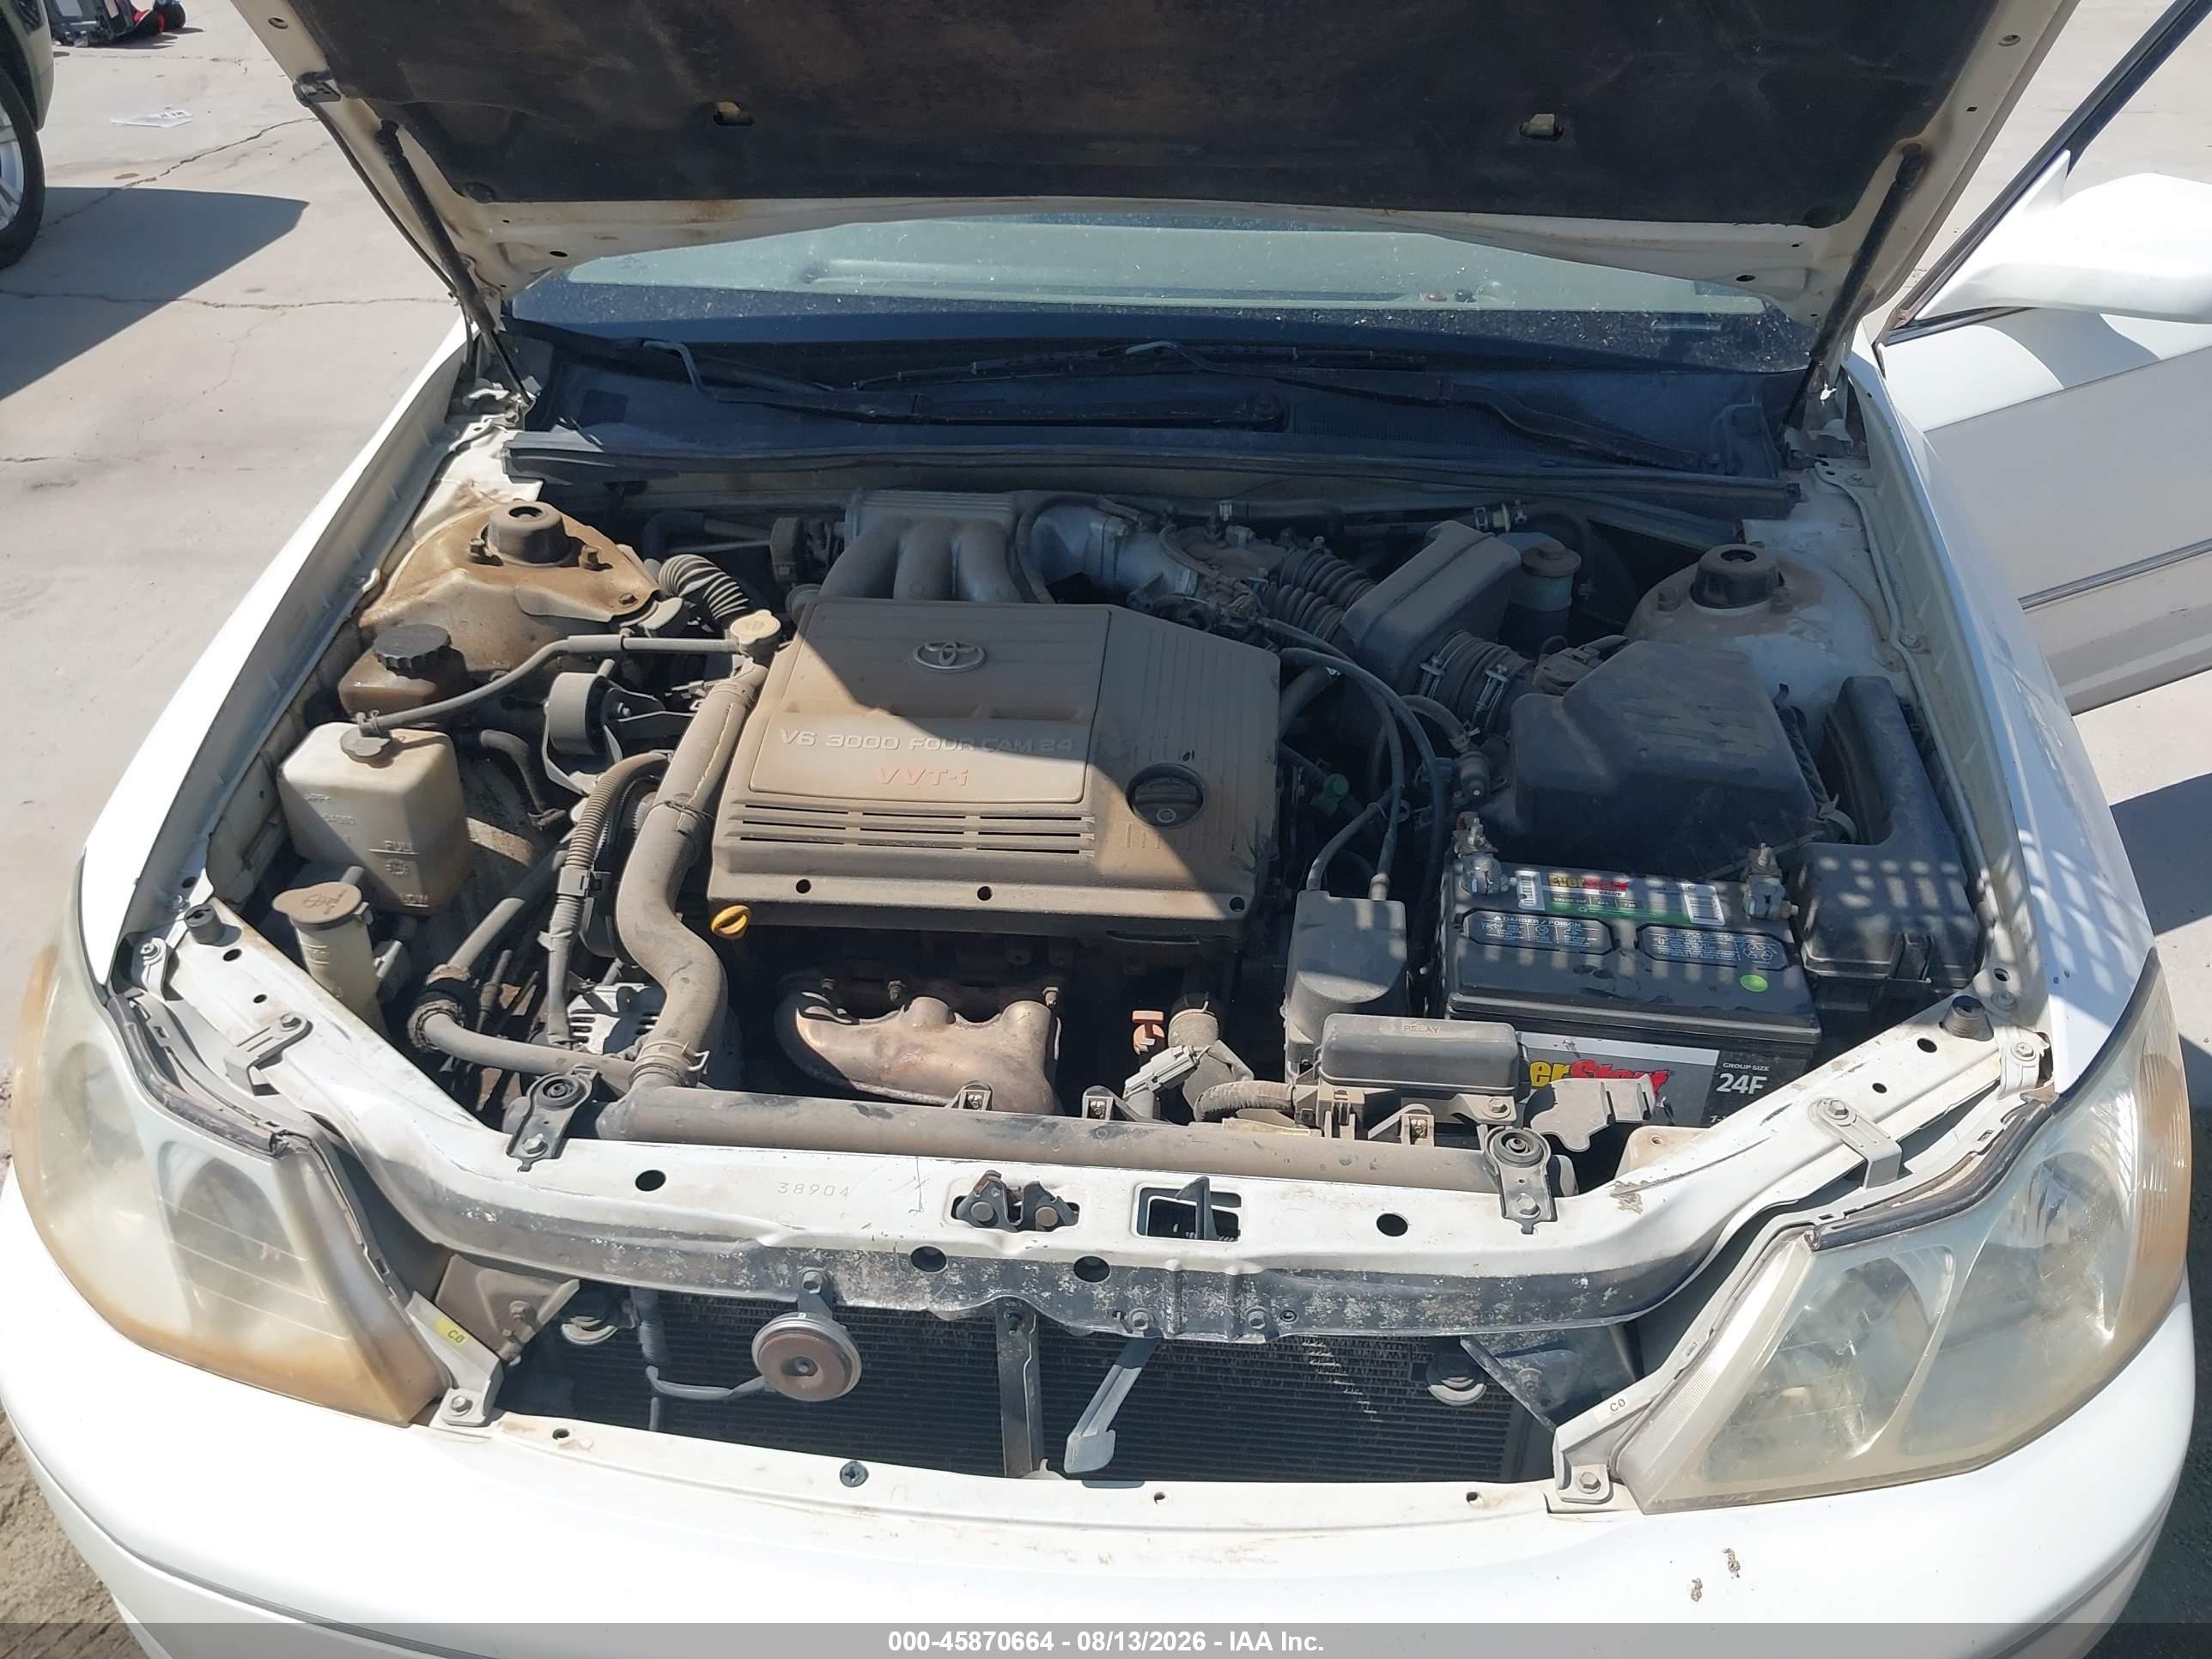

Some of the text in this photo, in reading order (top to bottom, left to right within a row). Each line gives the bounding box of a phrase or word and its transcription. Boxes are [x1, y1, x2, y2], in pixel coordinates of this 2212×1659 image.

[780, 728, 1073, 753] V6 3000 FOUR CAM 24
[384, 840, 413, 852] FULL
[1402, 1024, 1441, 1034] RELAY
[1723, 1062, 1751, 1071] GROUP
[1716, 1073, 1768, 1095] 24F
[777, 1182, 849, 1200] 38904
